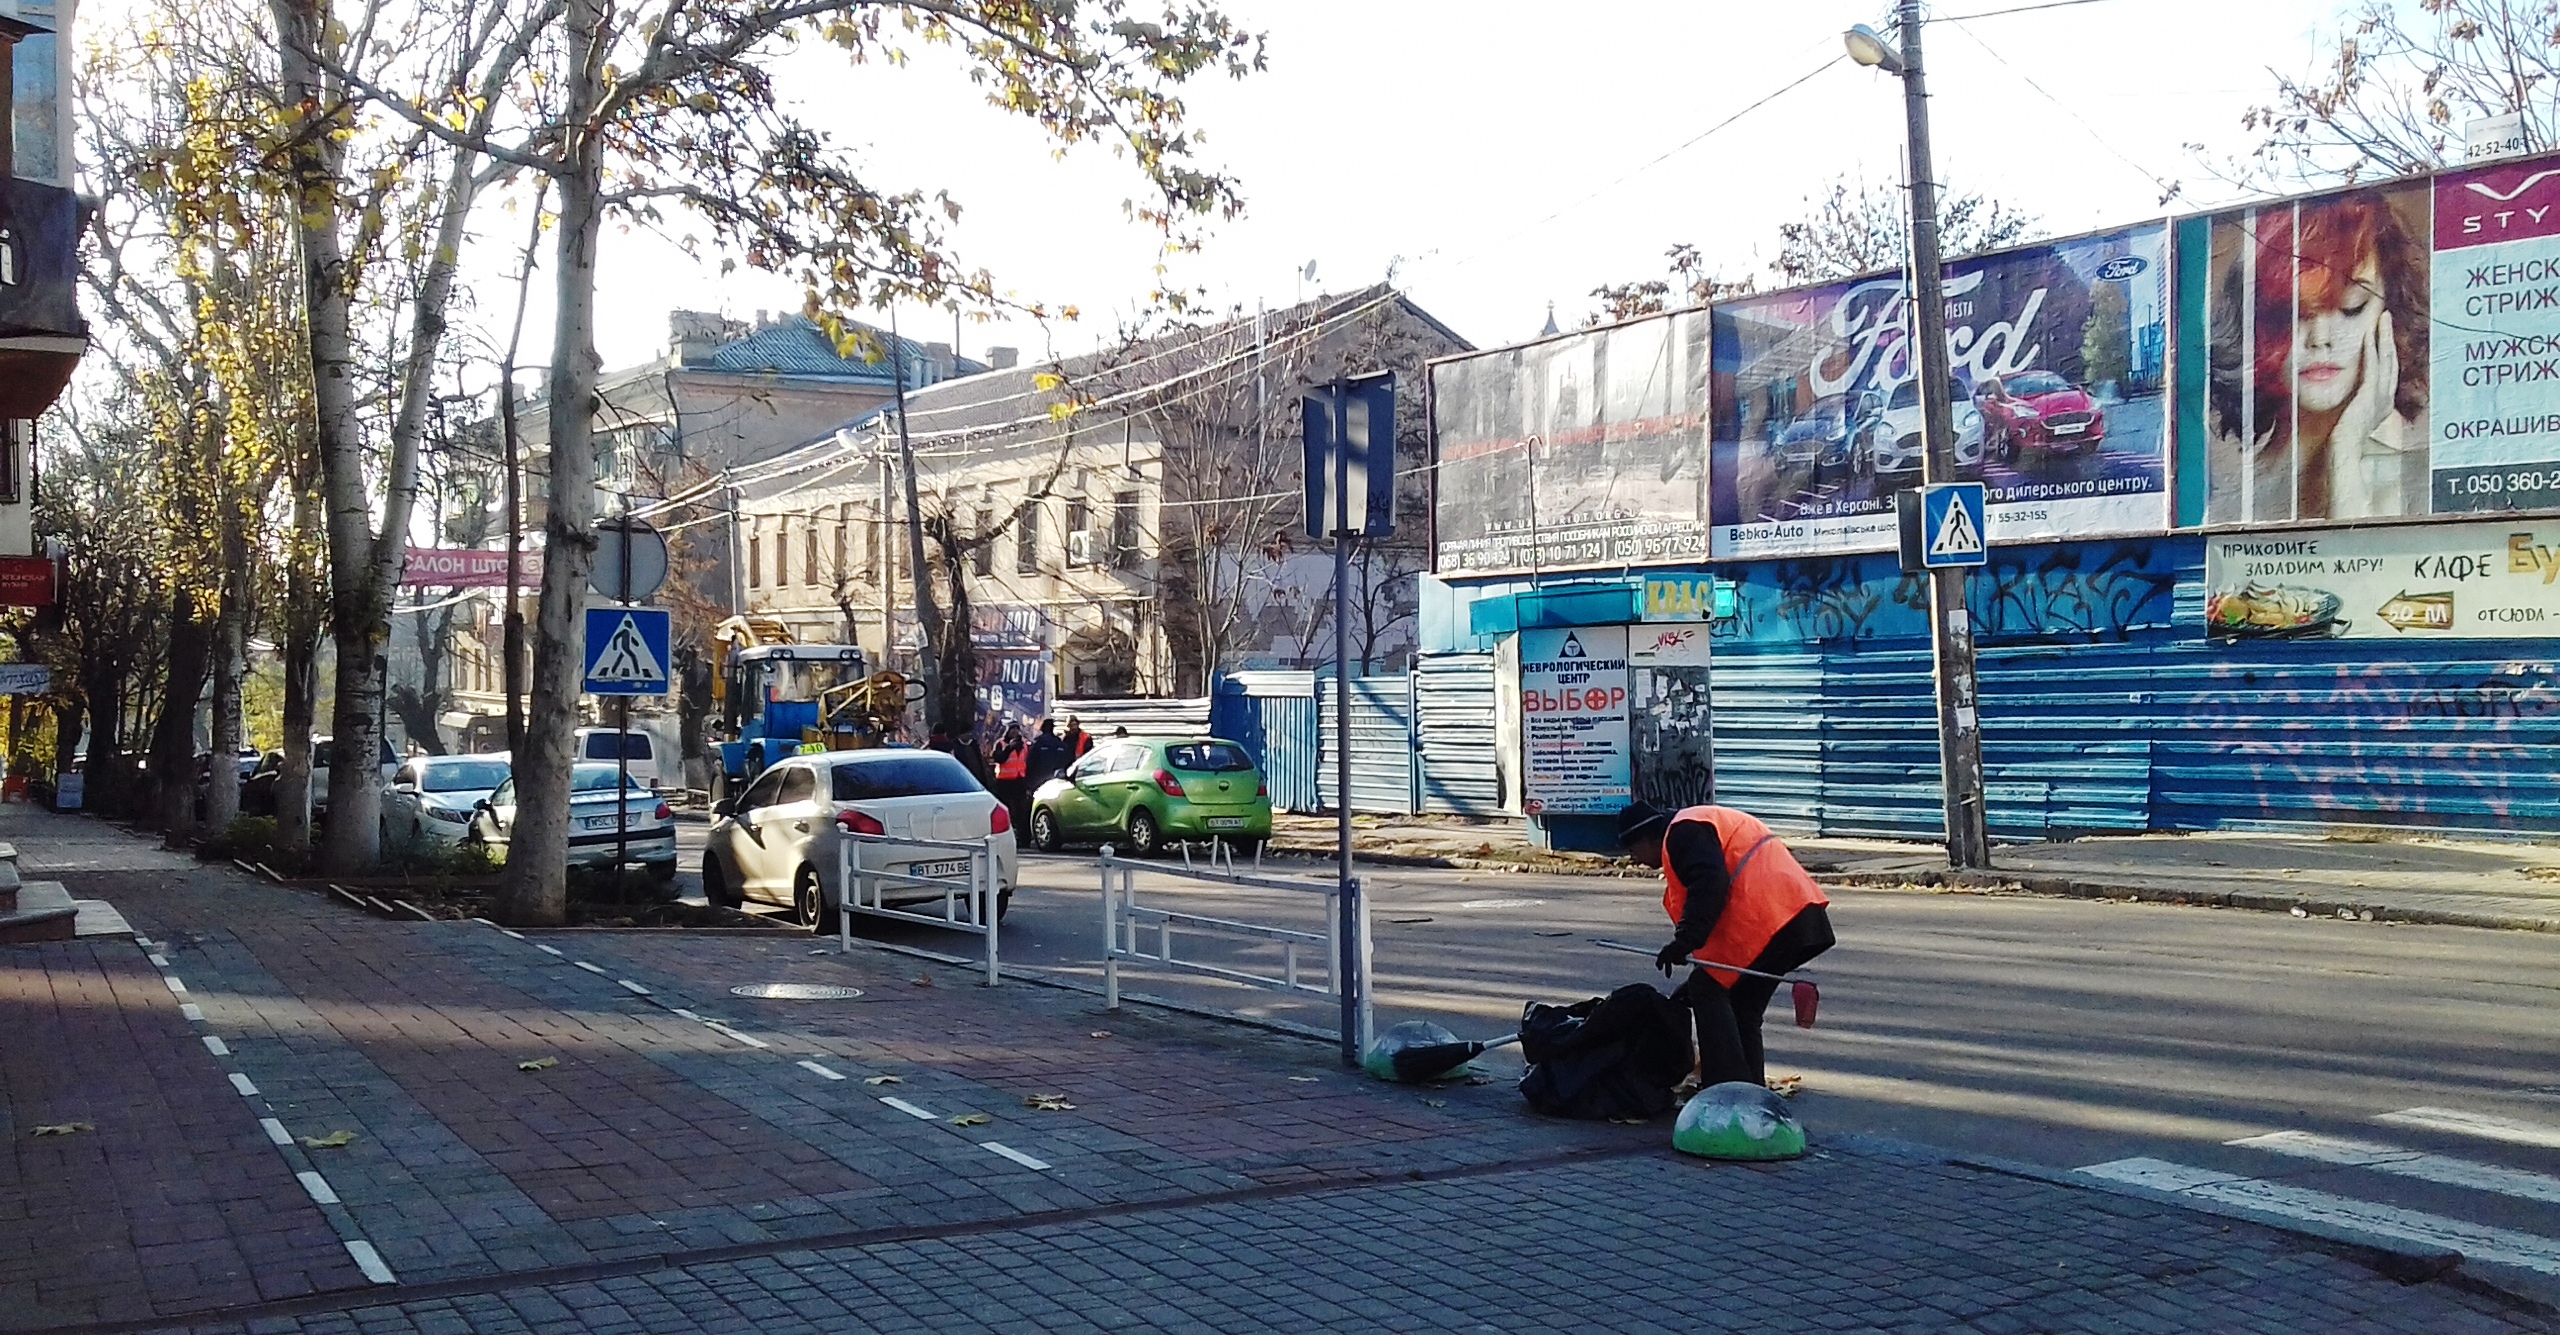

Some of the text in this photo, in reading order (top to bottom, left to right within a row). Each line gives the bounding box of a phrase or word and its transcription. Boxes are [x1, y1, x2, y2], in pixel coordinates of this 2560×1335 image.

[2467, 137, 2519, 158] 42-52-40
[2462, 204, 2551, 234] STY
[2104, 260, 2140, 278] Ford
[2465, 257, 2560, 290] ЖЕНСК
[1944, 301, 1974, 319] FIESTA
[2465, 286, 2560, 317] СТРИЖ
[2465, 332, 2560, 363] МУЖСК
[2462, 358, 2560, 387] СТРИЖ
[2443, 414, 2560, 440] ОКРАШИВ
[1835, 497, 1883, 515] Херсоні.
[2006, 481, 2095, 501] дилерського
[2098, 474, 2153, 497] центру.
[2466, 474, 2503, 495] 050
[2506, 470, 2560, 493] 360-2
[1729, 524, 1804, 542] Bebko-Auto
[1998, 510, 2048, 524] 55-32-155
[1437, 554, 1461, 570] (068)
[1462, 552, 1476, 567] 36
[1478, 551, 1492, 565] 90
[1493, 550, 1511, 565] 124
[1549, 545, 1562, 560] 10
[1564, 544, 1577, 560] 71
[1580, 542, 1601, 558] 124
[1614, 539, 1643, 560] (050)
[1644, 537, 1662, 554] 96
[1663, 536, 1680, 555] 77
[1683, 534, 1706, 553] 924
[2223, 540, 2320, 559] ПРИХОДИТЕ
[2245, 558, 2384, 577] ЗАДАДИМ ЖАРУ!
[2414, 553, 2492, 582] КАФЕ
[1557, 673, 1591, 685] ЦЕНТР
[1523, 685, 1626, 713] ВЫБОР
[917, 865, 931, 875] BT
[934, 863, 956, 874] 3774
